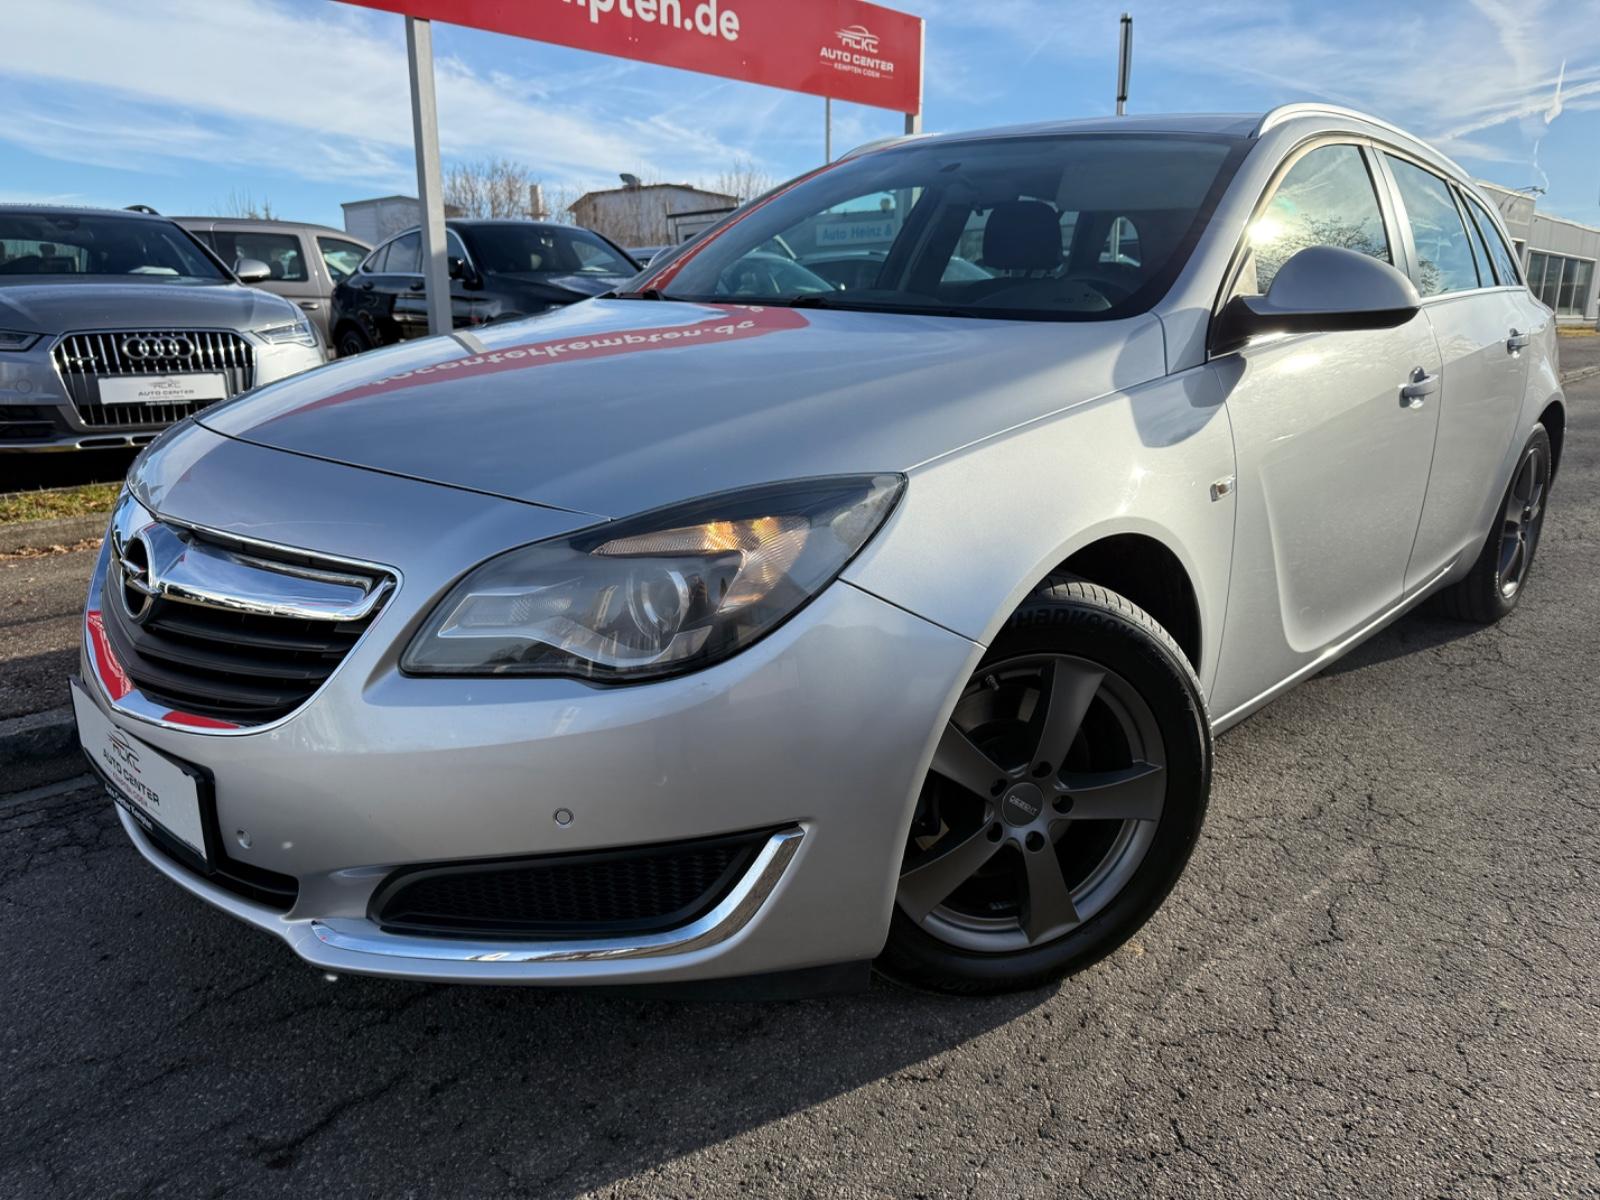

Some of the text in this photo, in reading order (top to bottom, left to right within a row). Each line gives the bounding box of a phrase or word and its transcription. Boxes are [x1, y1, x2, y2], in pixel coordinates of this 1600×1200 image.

[820, 47, 894, 73] AUTO CENTER
[103, 748, 122, 775] AUTO
[122, 768, 160, 806] CENTER
